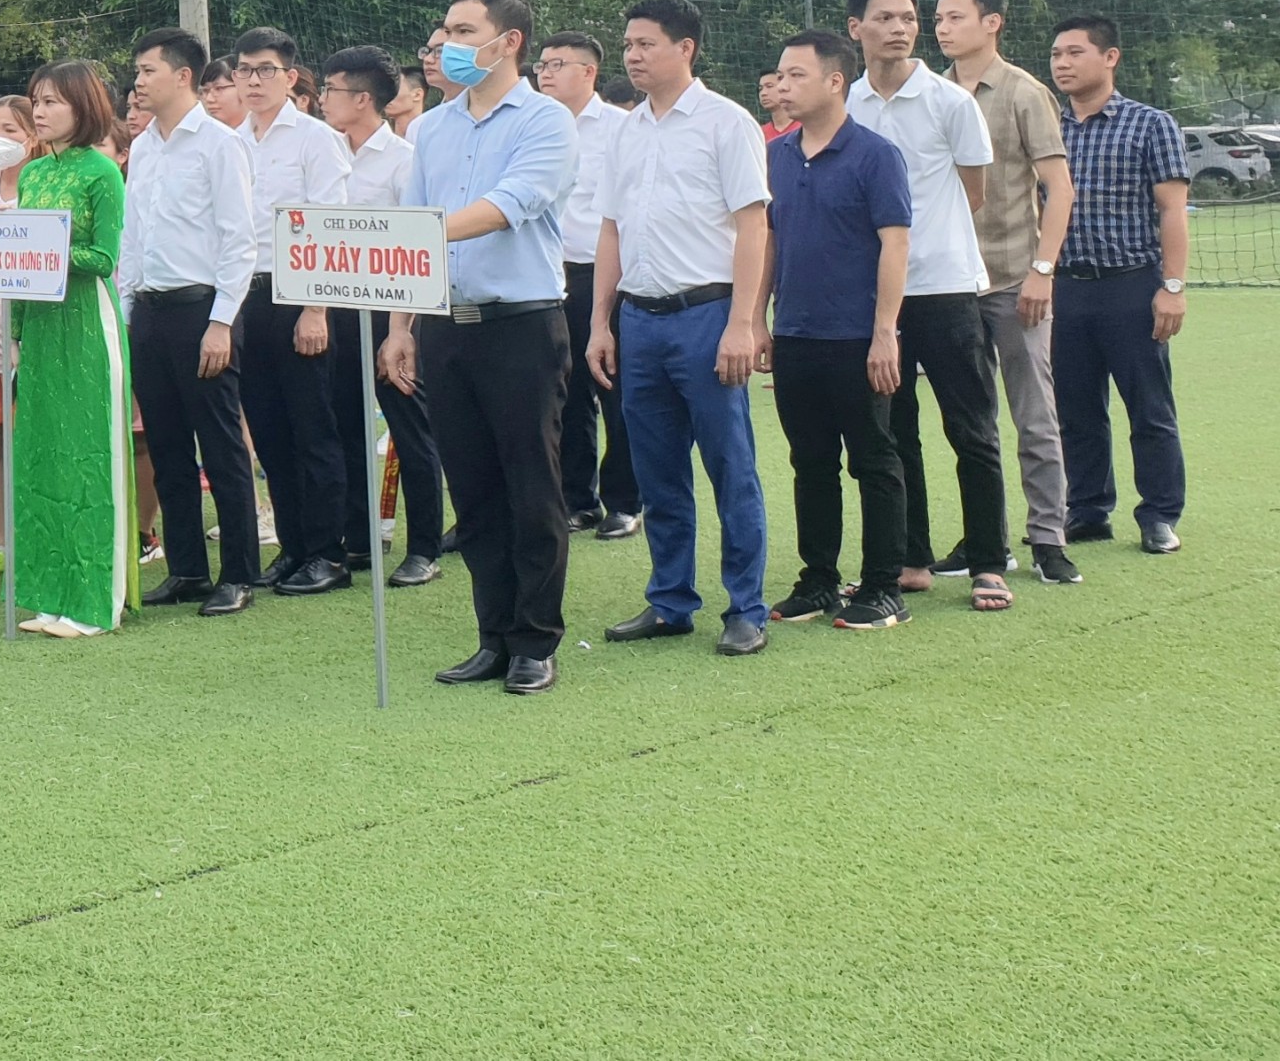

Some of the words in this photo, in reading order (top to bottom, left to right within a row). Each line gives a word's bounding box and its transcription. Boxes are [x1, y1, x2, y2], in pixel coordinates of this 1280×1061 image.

[323, 218, 345, 230] CHI
[349, 216, 389, 231] ĐOÀN
[4, 251, 17, 270] CN
[20, 250, 41, 271] HƯNG
[44, 249, 60, 271] YÊN
[289, 234, 317, 271] SỞ
[323, 240, 361, 274] XÂY
[369, 246, 431, 281] DỰNG
[353, 284, 370, 299] ĐÁ
